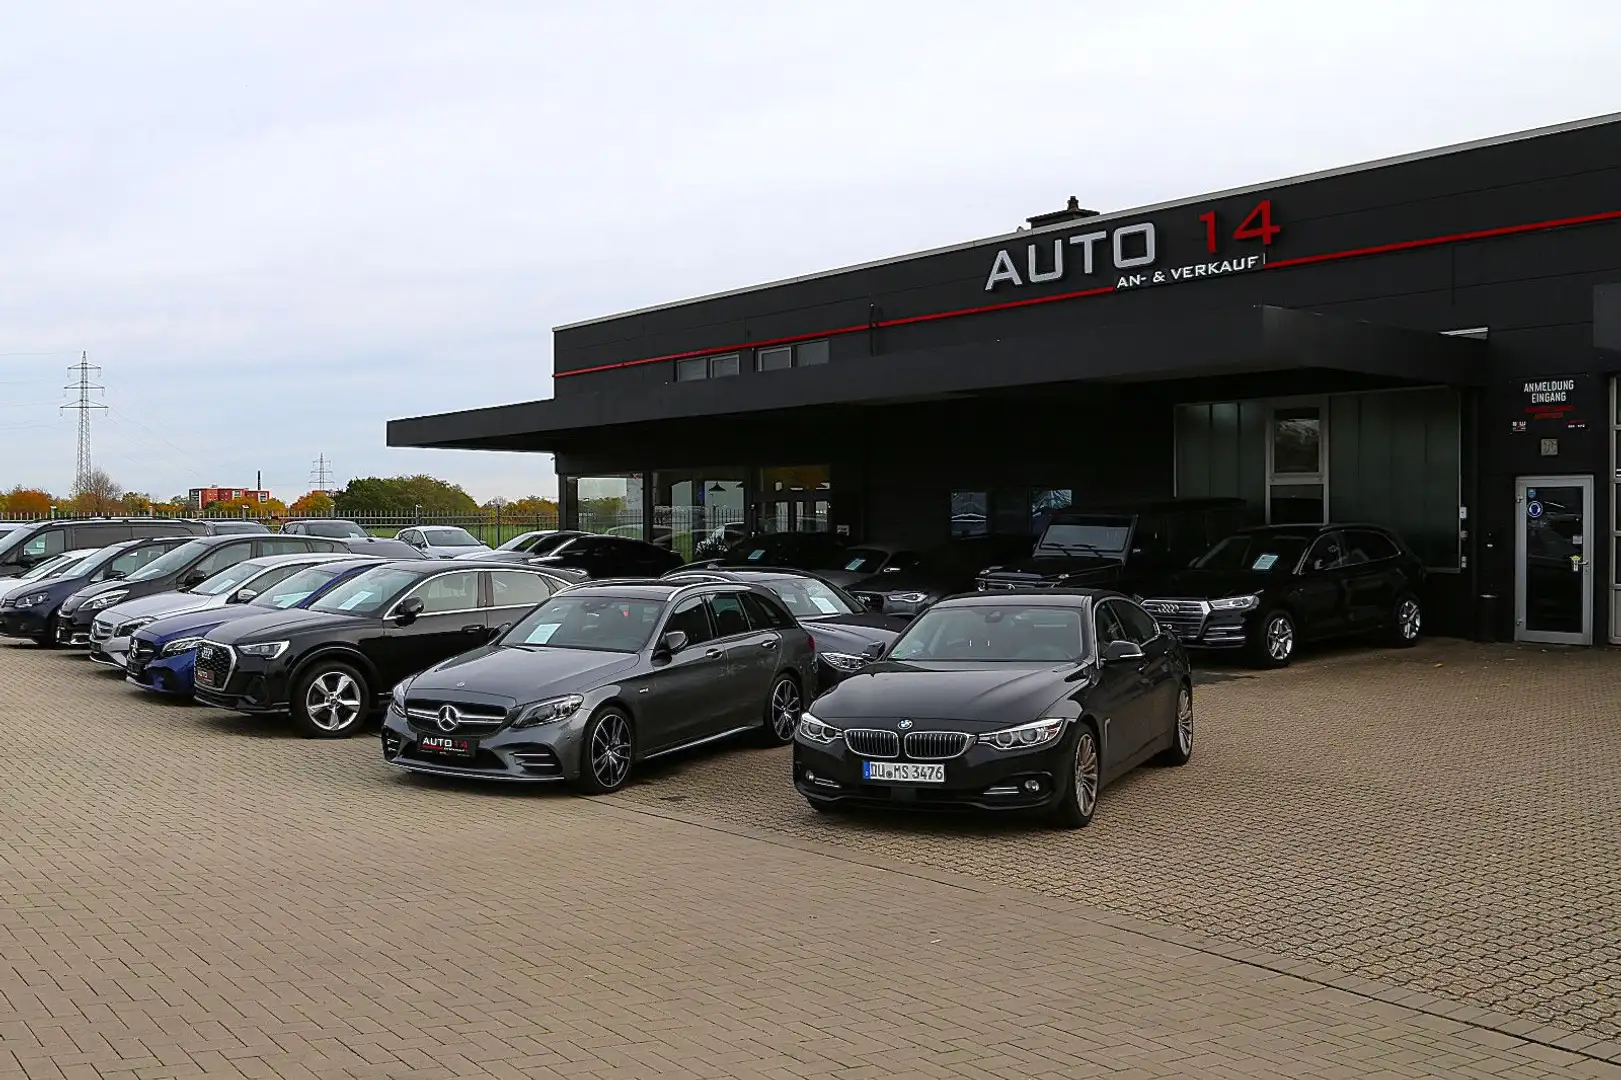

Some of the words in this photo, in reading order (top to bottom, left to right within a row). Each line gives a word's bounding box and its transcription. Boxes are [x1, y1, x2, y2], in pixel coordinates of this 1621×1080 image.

[985, 222, 1156, 291] AUTO
[1199, 199, 1281, 254] 14
[1116, 275, 1147, 289] AN-
[1152, 271, 1166, 283] &
[1170, 256, 1259, 280] VERKAUF
[1524, 380, 1574, 392] ANMELDUNG
[1531, 392, 1567, 404] EINGANG
[422, 736, 452, 747] AUTO
[894, 765, 909, 779] MS
[912, 766, 943, 780] 3476
